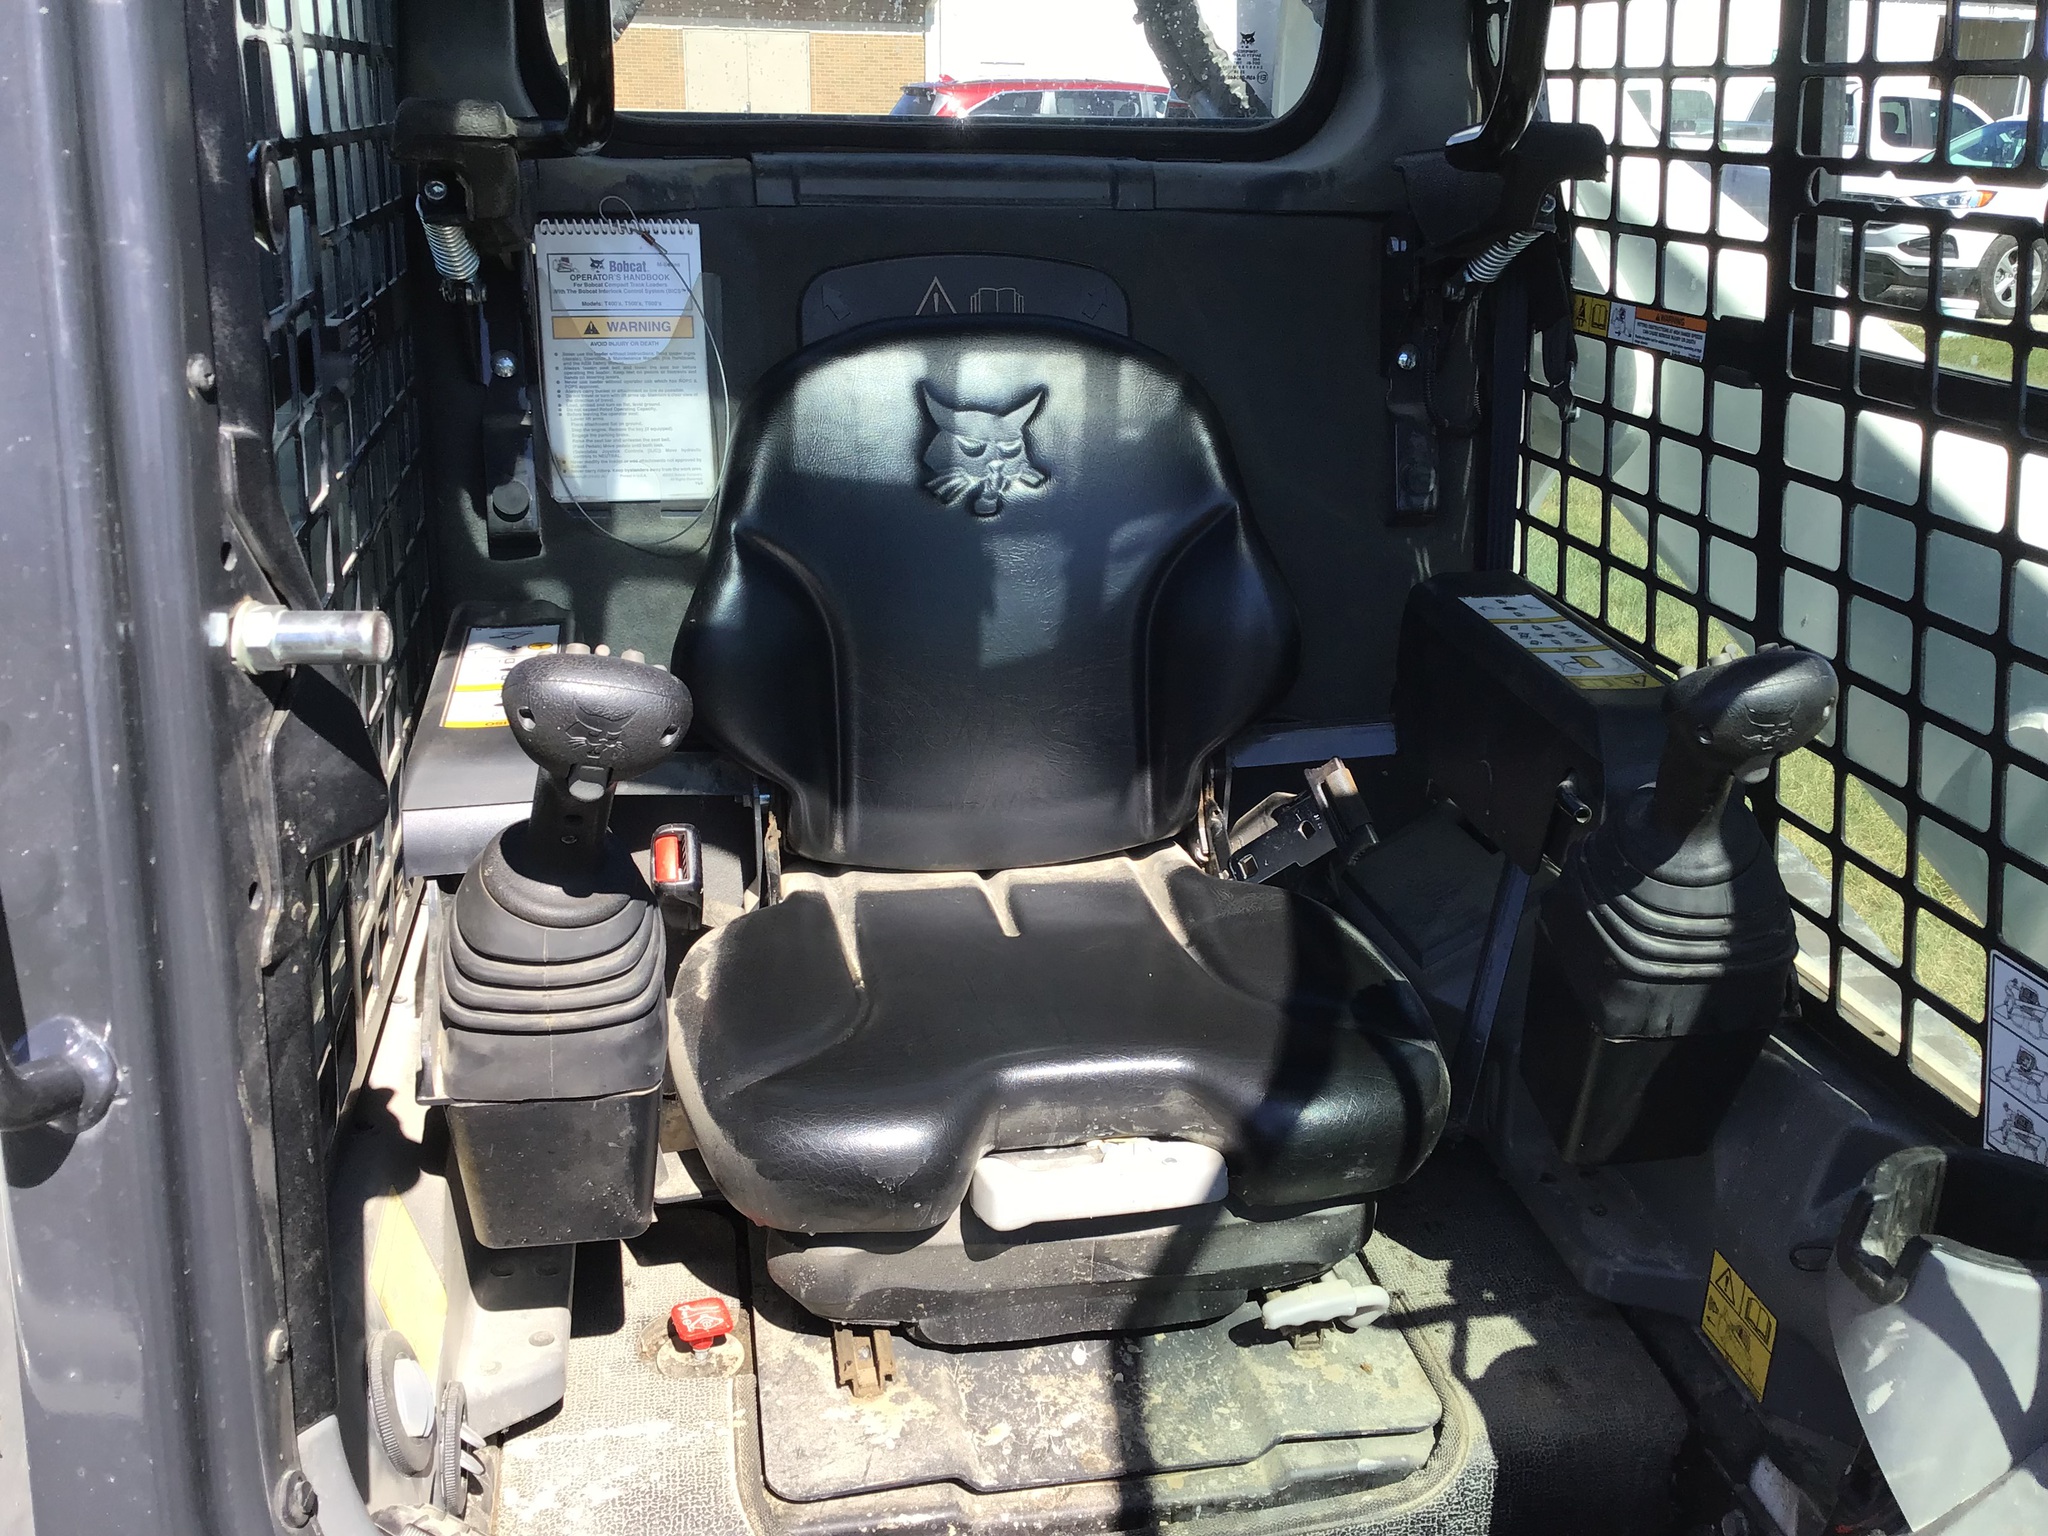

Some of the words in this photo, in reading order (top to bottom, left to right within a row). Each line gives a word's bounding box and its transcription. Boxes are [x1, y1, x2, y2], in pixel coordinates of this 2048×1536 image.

[609, 261, 646, 272] Bobcat
[570, 273, 621, 281] OPERATOR'S
[624, 273, 670, 281] HANDBOOK
[607, 321, 672, 333] WARNING
